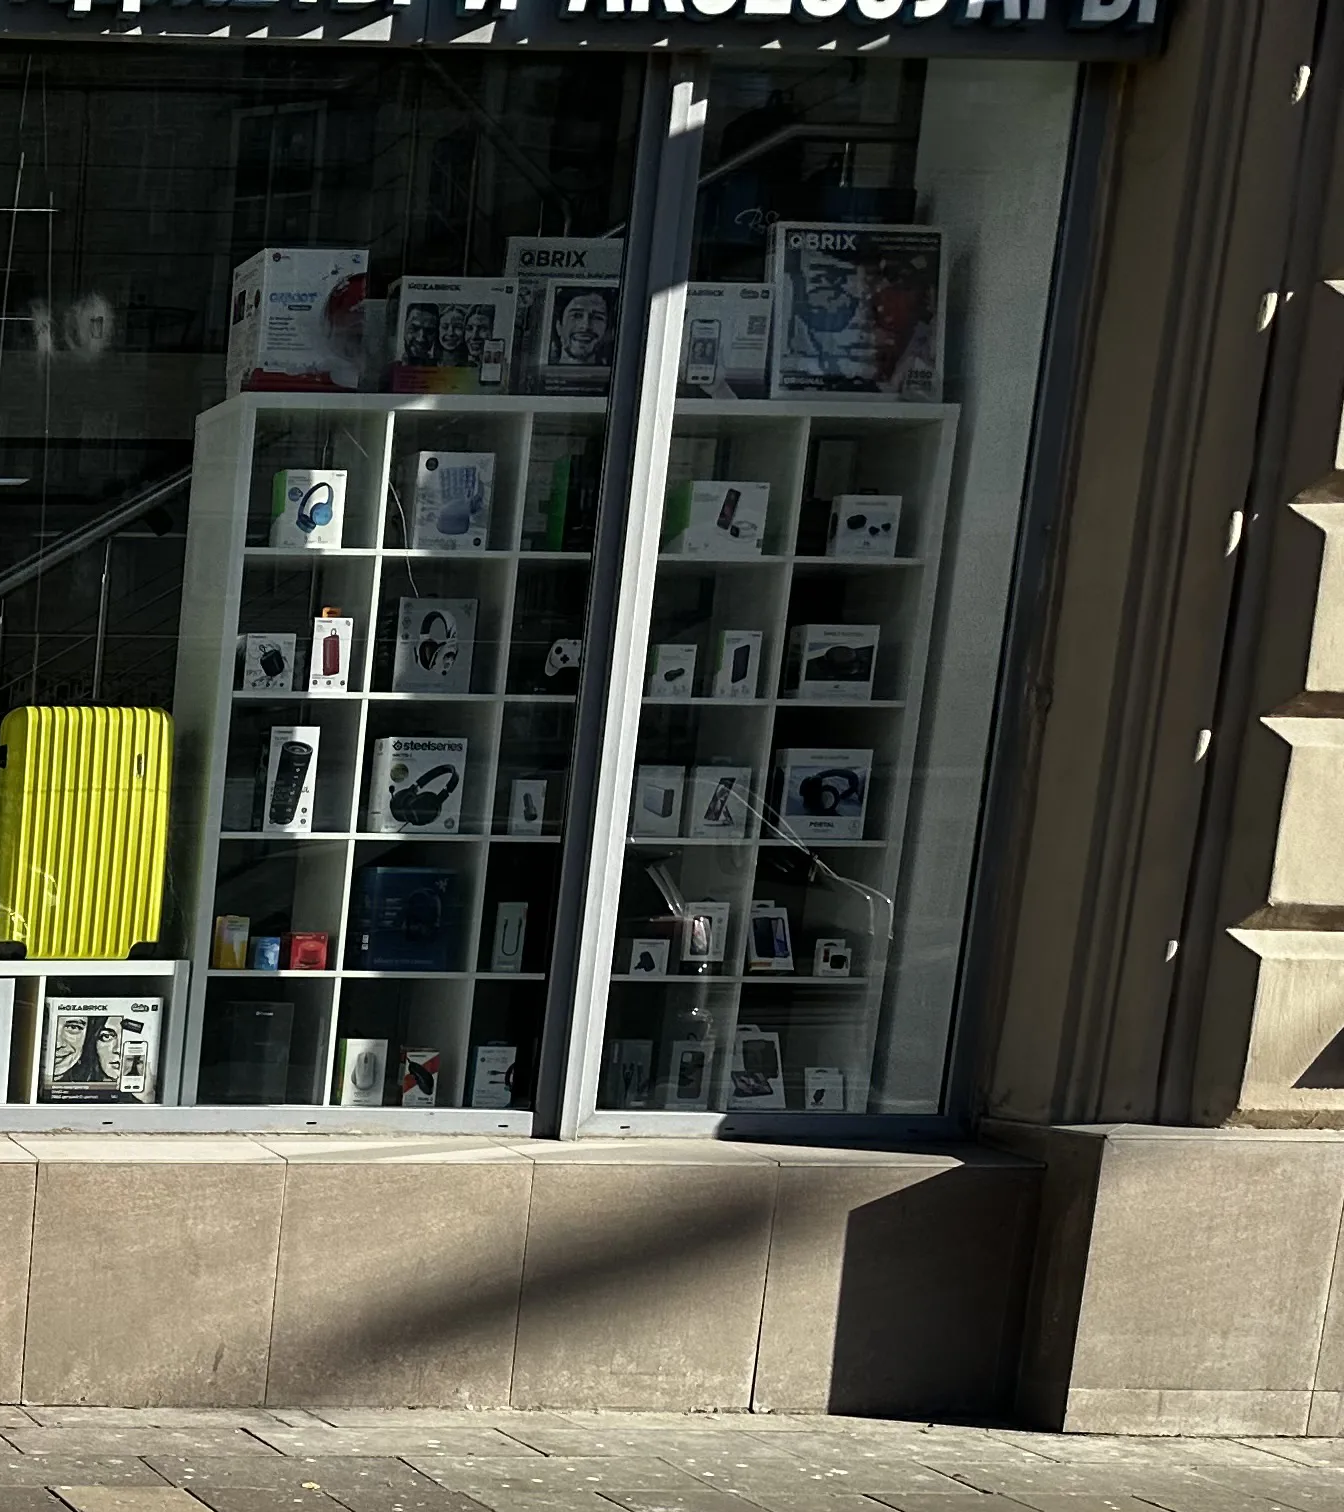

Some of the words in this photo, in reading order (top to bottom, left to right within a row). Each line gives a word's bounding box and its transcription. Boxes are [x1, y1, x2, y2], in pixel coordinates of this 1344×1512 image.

[787, 232, 857, 251] QBRIX
[520, 250, 588, 268] QBRIX
[403, 740, 463, 752] steelseries
